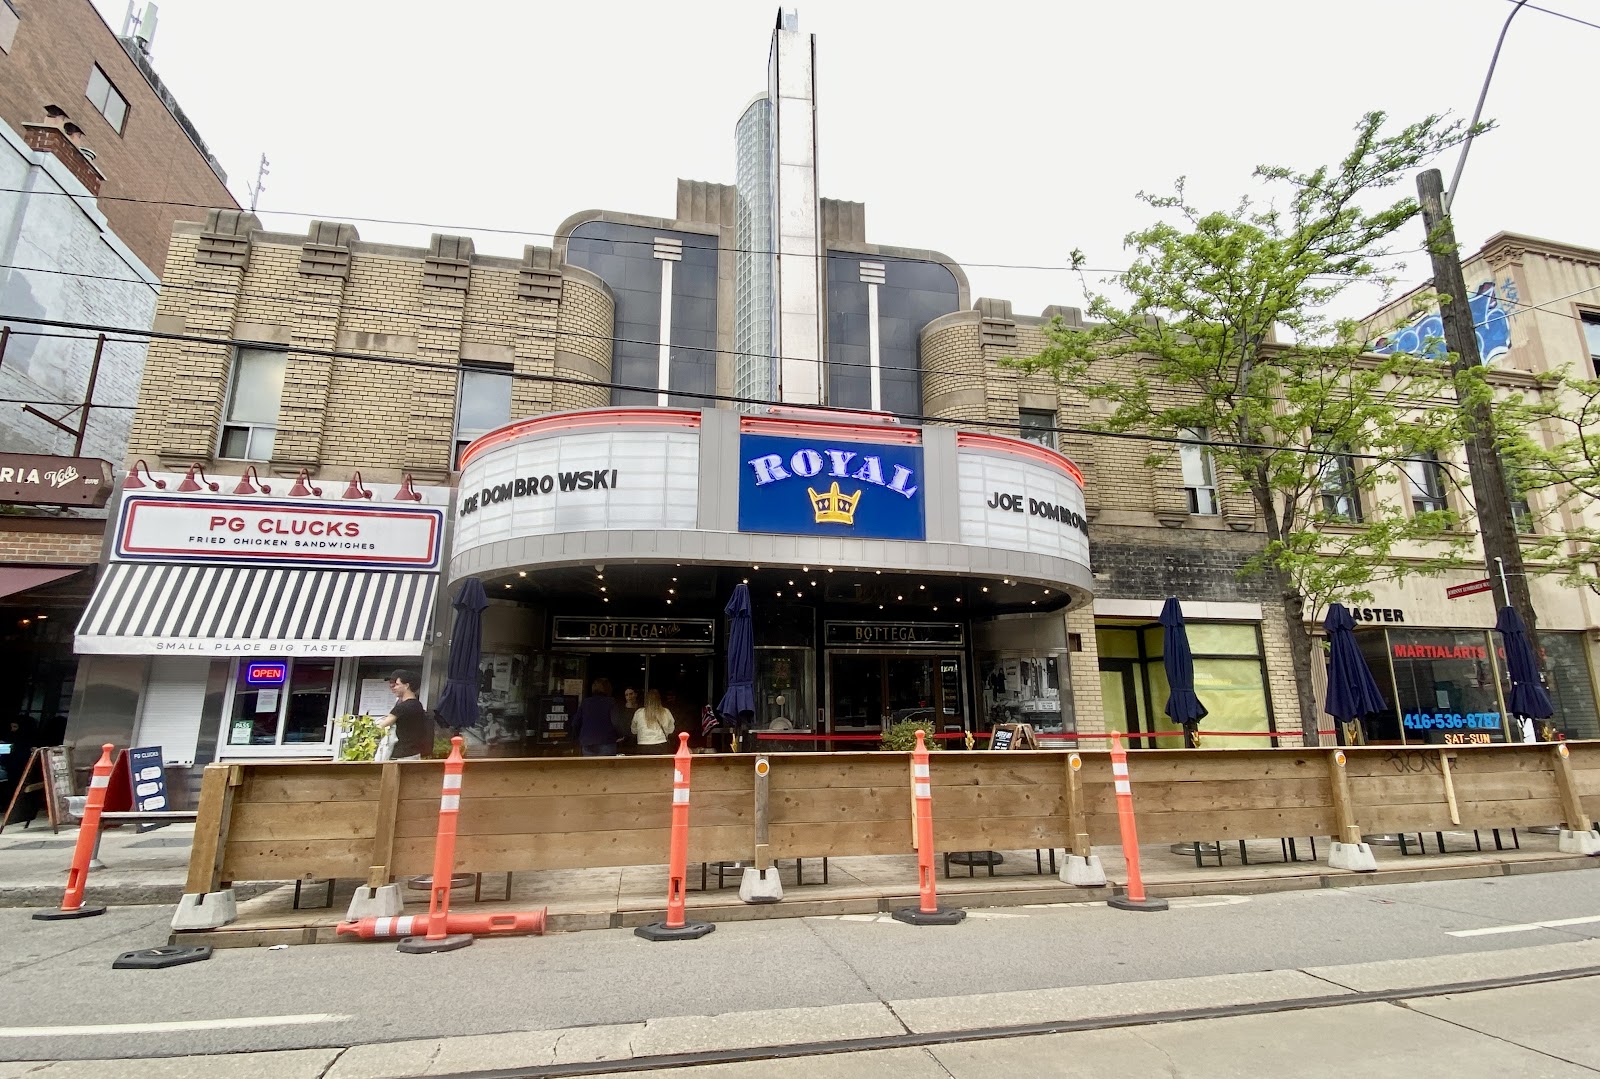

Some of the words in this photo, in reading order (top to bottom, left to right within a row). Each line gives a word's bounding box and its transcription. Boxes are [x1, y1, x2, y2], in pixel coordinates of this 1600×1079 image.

[748, 449, 918, 499] ROYAL
[459, 492, 479, 517] JOE
[988, 492, 1024, 513] JOE
[209, 516, 246, 532] PG
[257, 518, 360, 537] CLUCKS
[188, 536, 226, 544] FRIED
[233, 538, 288, 547] CHICKEN
[294, 540, 376, 550] SANDWICHES
[589, 623, 659, 637] BOTTEGA
[855, 627, 916, 640] BOTTEGA
[156, 642, 205, 650] SMALL
[215, 643, 261, 651] PLACE
[269, 643, 294, 651] BIG
[304, 644, 347, 652] TASTE
[252, 669, 281, 678] OPEN
[1404, 713, 1500, 729] 416-536-8787
[1444, 733, 1491, 745] SAT-SUN
